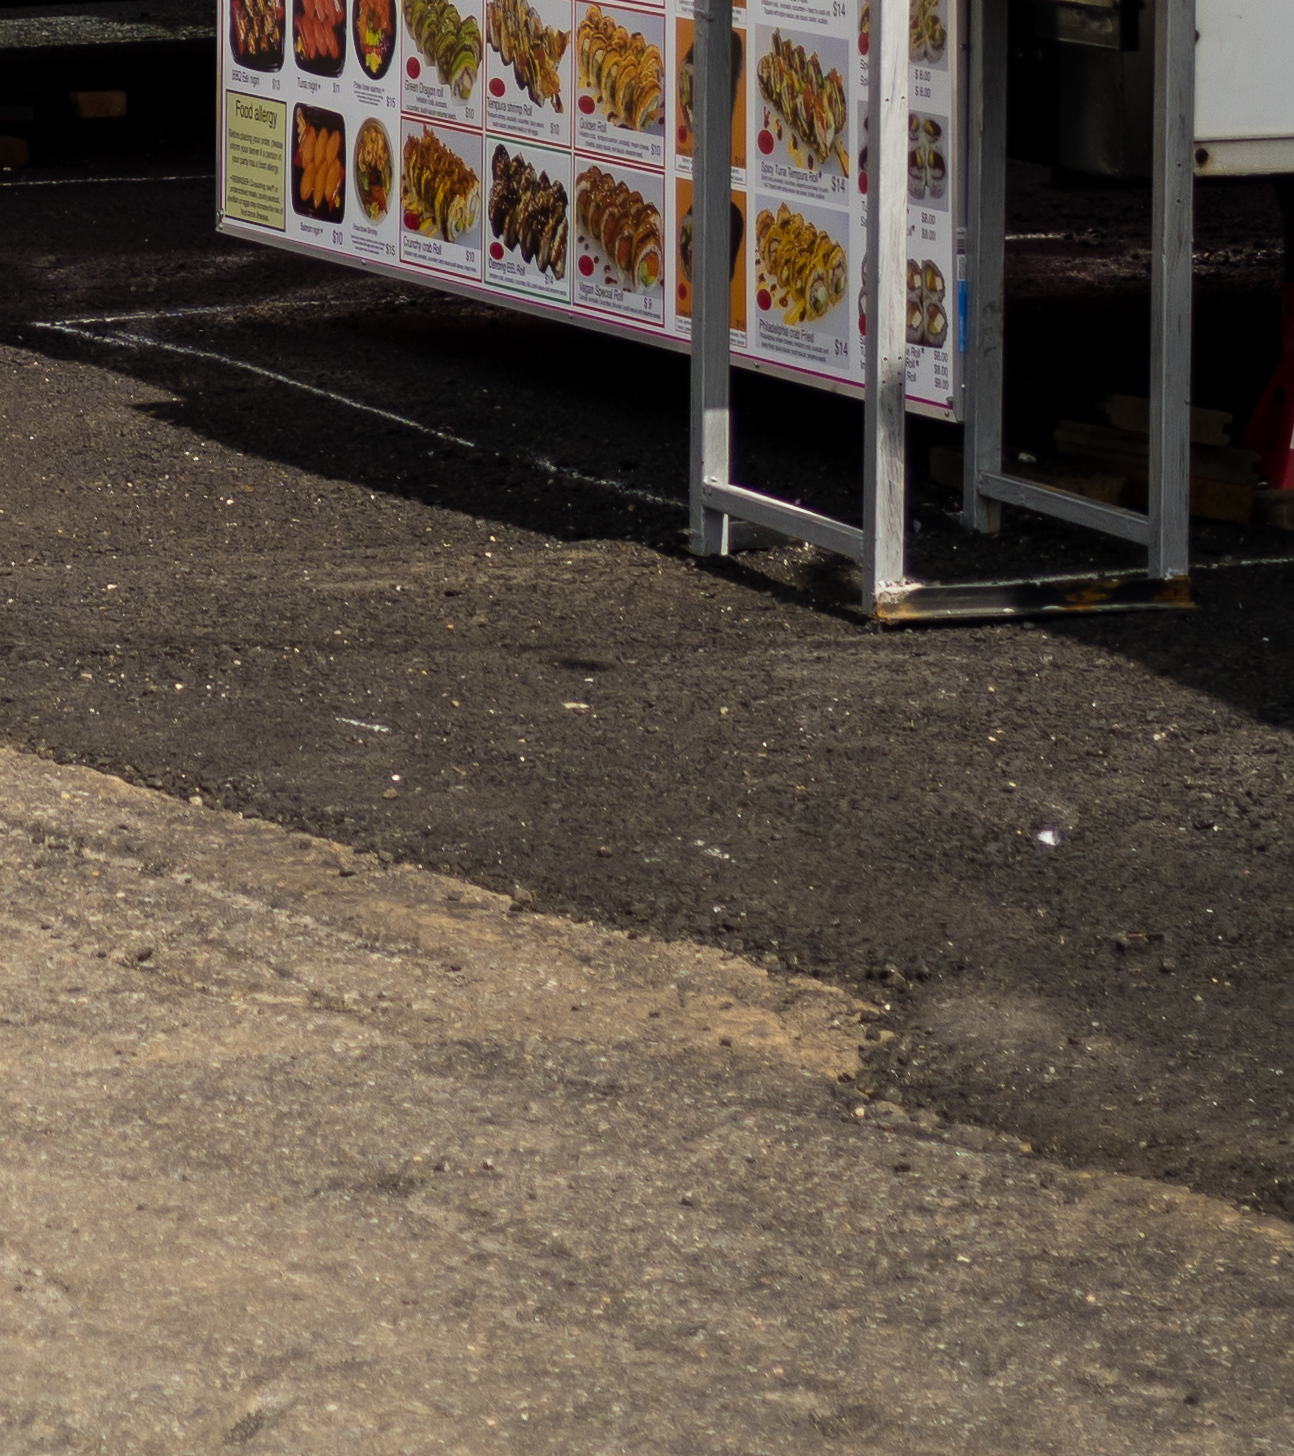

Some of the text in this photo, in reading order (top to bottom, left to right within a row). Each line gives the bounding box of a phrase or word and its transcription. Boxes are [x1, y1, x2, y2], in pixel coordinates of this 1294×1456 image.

[832, 1, 846, 17] $14
[405, 80, 420, 92] Green
[420, 83, 435, 97] Dragon
[386, 96, 396, 108] $15
[487, 97, 533, 117] Tempura shrimp Roll
[236, 100, 278, 130] Food allergy
[465, 107, 474, 119] $10
[579, 117, 607, 133] Golden Roll
[651, 143, 660, 156] $10
[761, 161, 774, 176] Spicy
[774, 163, 787, 177] Tuna
[788, 167, 808, 182] Tempura
[831, 176, 846, 193] $14
[921, 212, 936, 225] $8.00
[333, 231, 343, 245] $10
[921, 228, 936, 241] $8.00
[386, 243, 395, 256] $15
[403, 235, 442, 255] Crunchy crab Roll
[466, 250, 475, 263] $10
[488, 258, 506, 274] Dancing
[516, 265, 525, 276] Roll
[579, 282, 623, 302] Vegan Special Roll
[759, 319, 789, 338] Philadelphia
[834, 339, 848, 357] $14
[934, 350, 949, 363] $8.00
[934, 364, 949, 378] $8.00
[934, 379, 949, 391] $8.00
